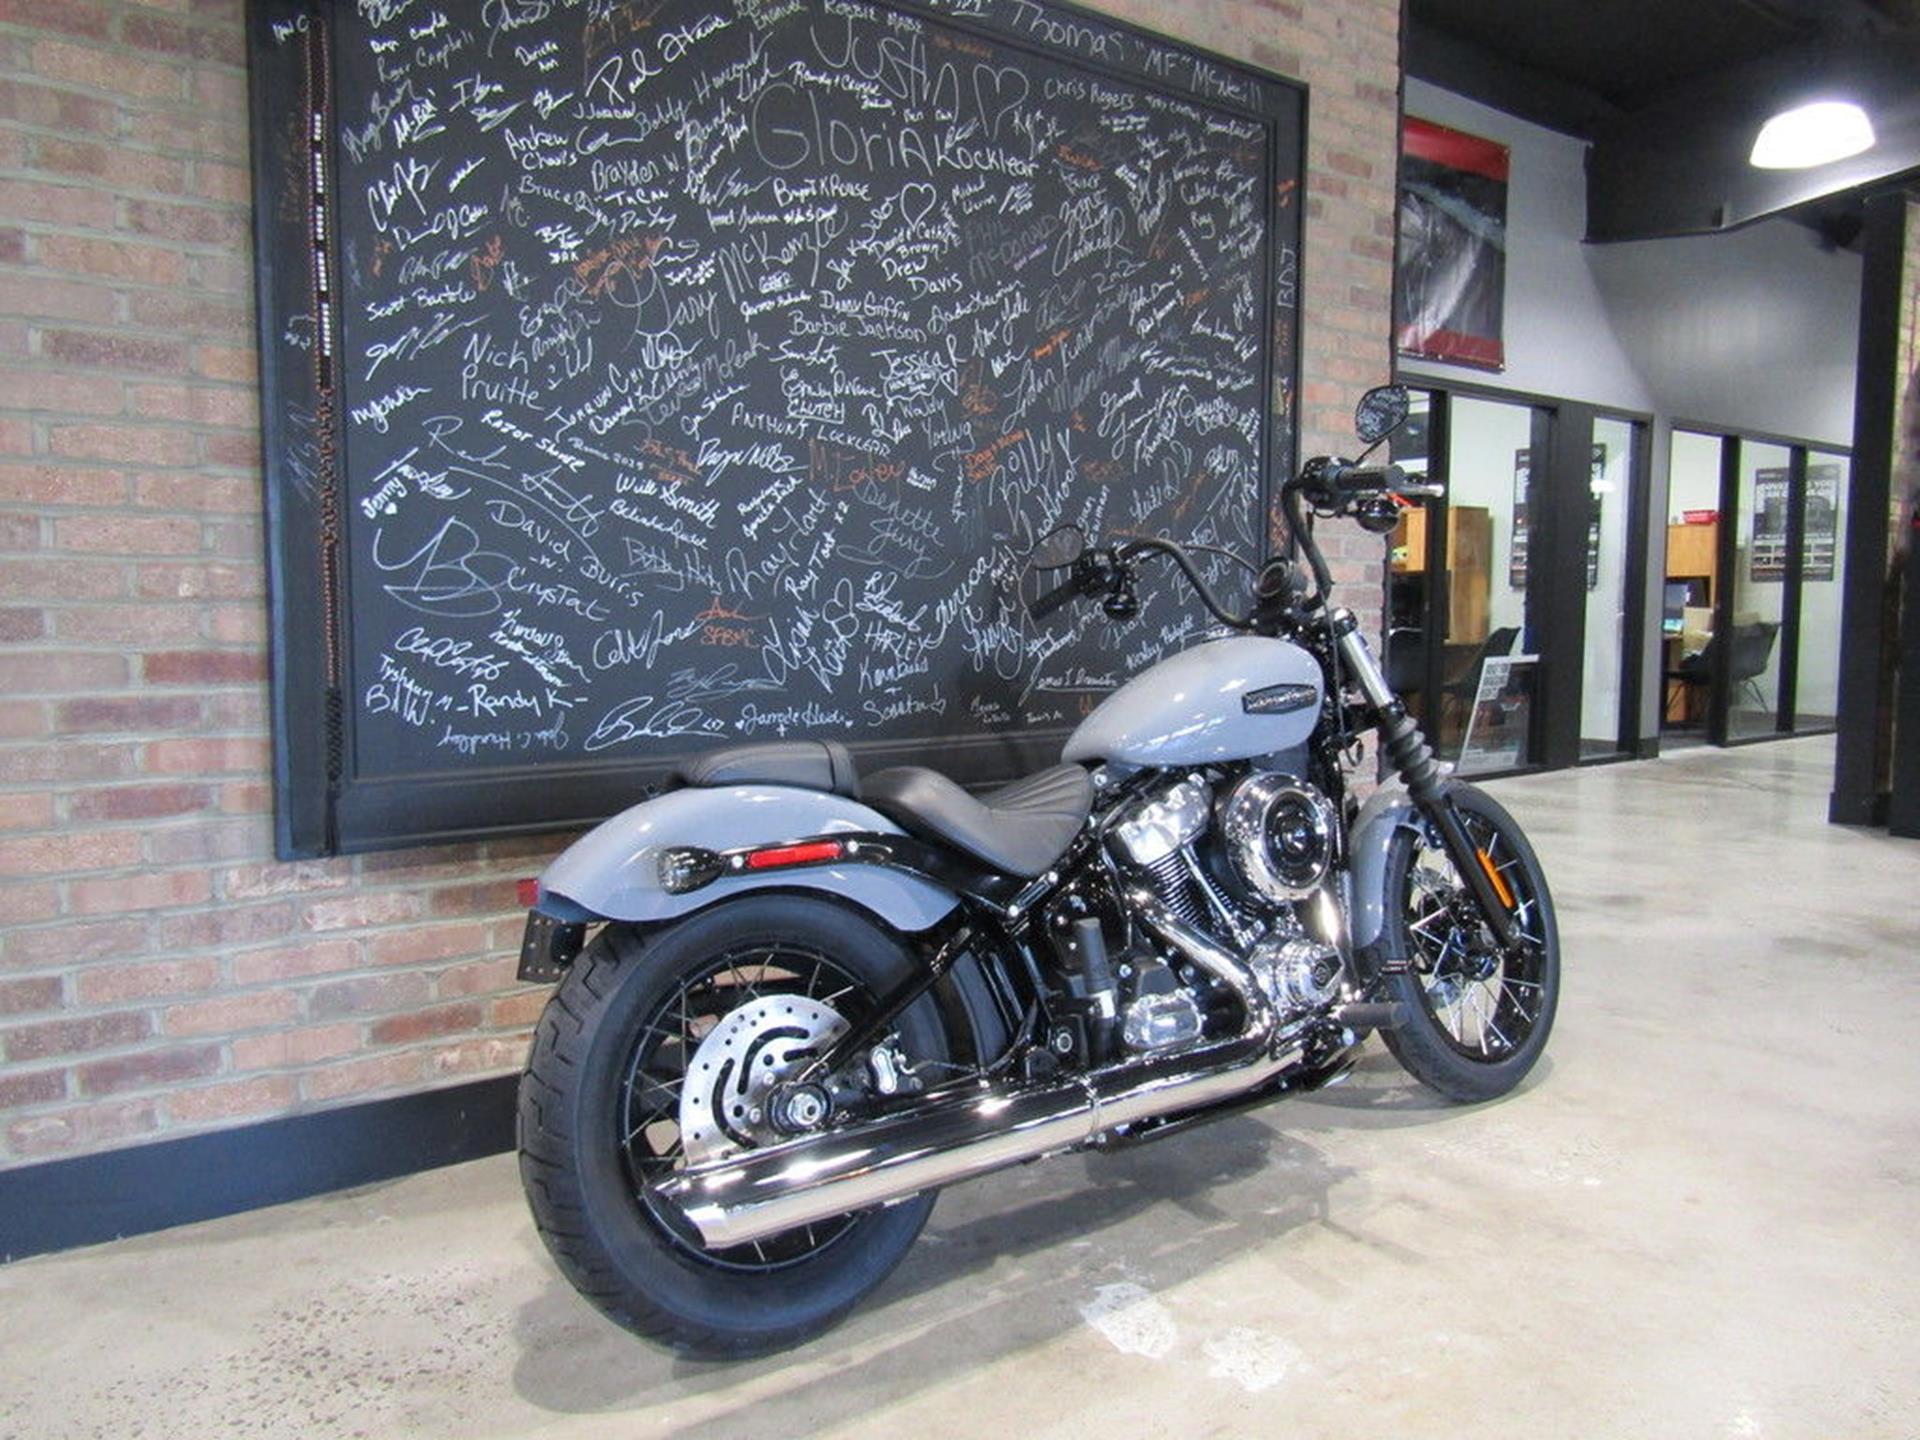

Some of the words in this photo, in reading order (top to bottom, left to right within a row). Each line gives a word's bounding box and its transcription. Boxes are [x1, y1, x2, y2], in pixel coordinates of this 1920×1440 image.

[881, 254, 928, 282] Drew
[907, 272, 964, 301] Davis
[464, 332, 529, 374] Nick
[485, 499, 572, 563] David
